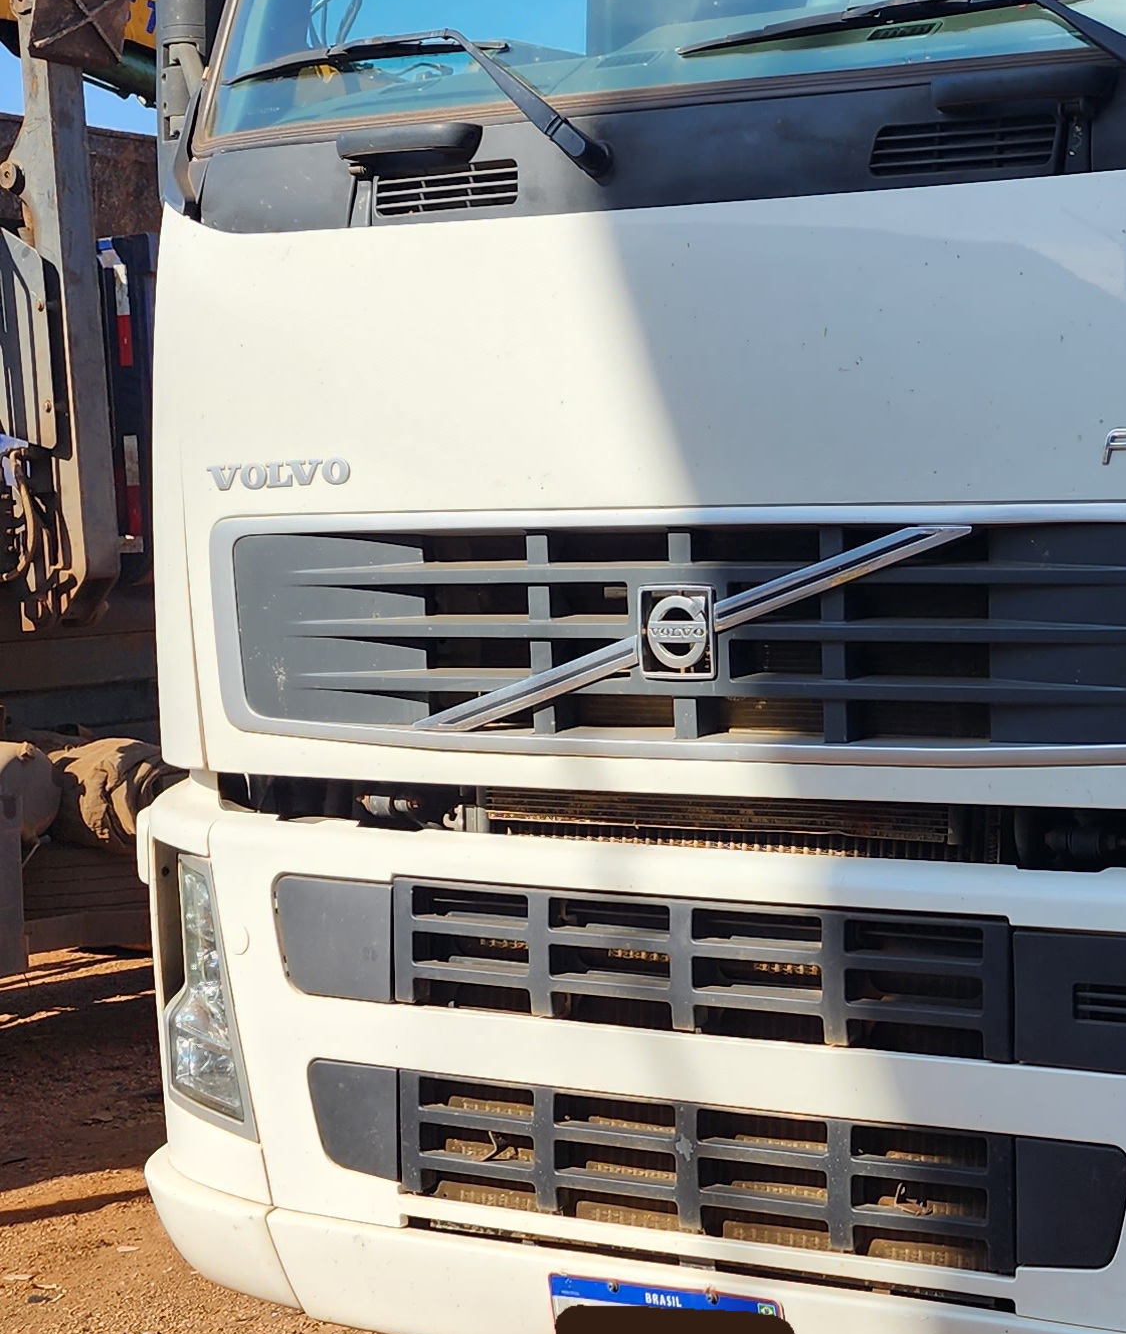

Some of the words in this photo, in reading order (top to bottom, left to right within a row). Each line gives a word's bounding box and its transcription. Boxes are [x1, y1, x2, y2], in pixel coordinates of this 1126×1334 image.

[207, 457, 351, 491] VOLVO
[648, 626, 705, 639] VOLVO
[645, 1292, 682, 1309] BRASIL
